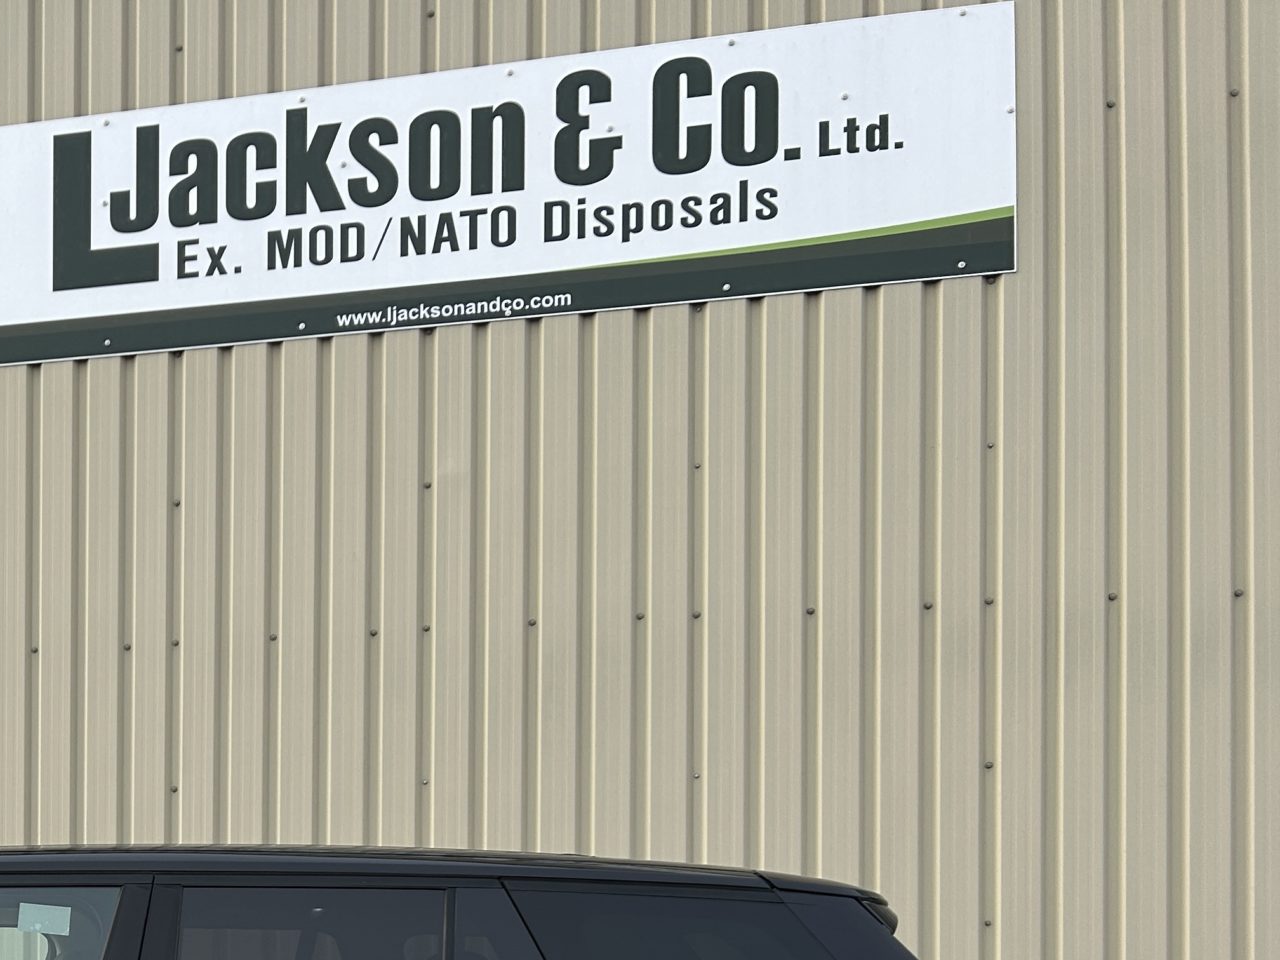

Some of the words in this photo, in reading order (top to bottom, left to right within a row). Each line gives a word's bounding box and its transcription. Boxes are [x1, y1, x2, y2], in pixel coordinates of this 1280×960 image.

[553, 69, 623, 187] &
[651, 56, 801, 176] Co.
[818, 113, 904, 158] Ltd.
[176, 238, 242, 280] Ex.
[267, 205, 517, 271] MOD/NATO
[543, 179, 779, 243] Disposals
[336, 293, 572, 327] www.ljacksonandco.com
